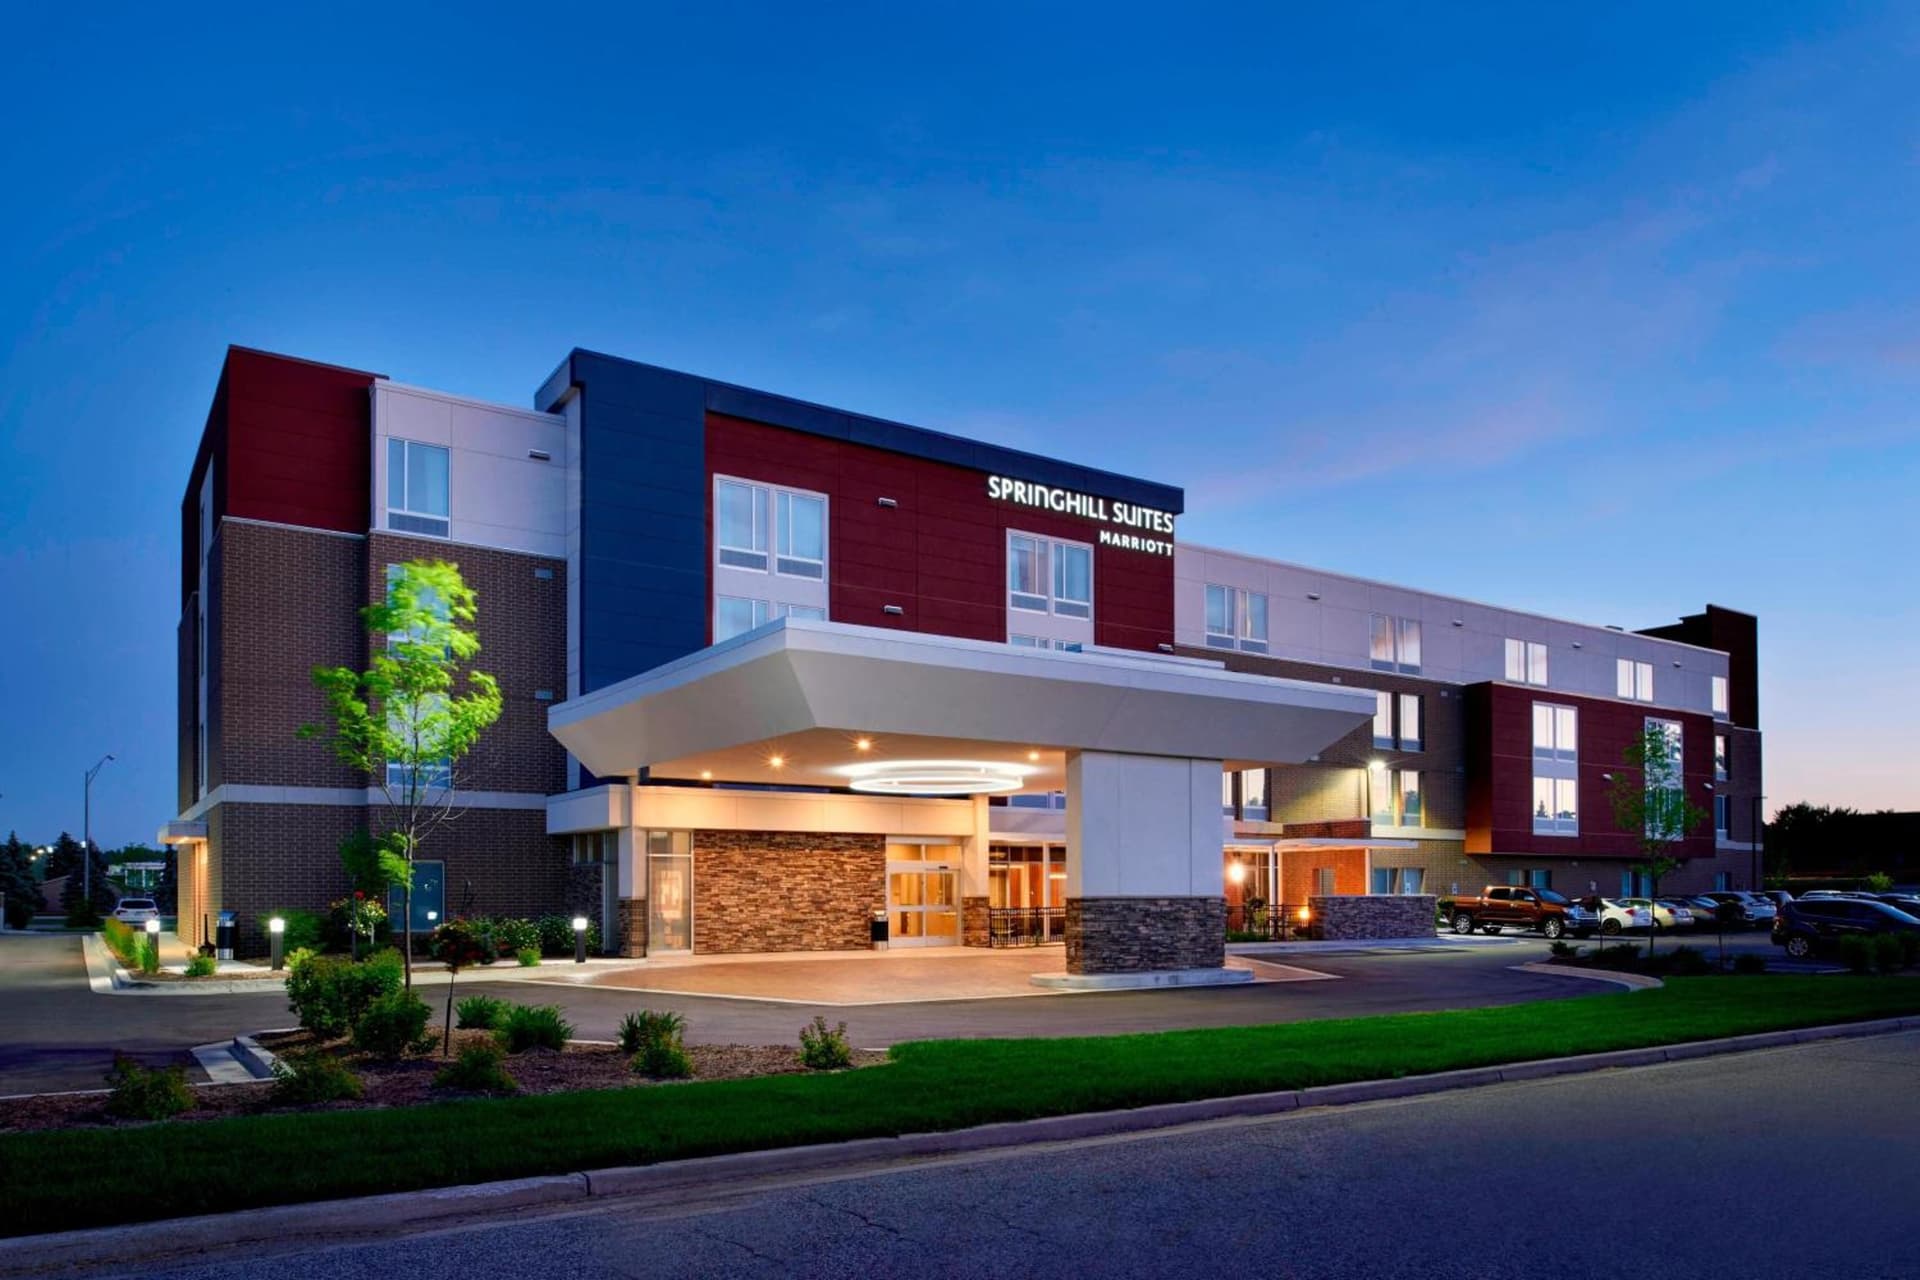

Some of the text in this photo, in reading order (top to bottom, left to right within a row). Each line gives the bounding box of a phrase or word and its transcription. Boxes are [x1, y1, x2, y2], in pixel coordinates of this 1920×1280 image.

[988, 475, 1174, 533] SPRINGHILL SUITES
[1099, 530, 1174, 556] MARRIOTT
